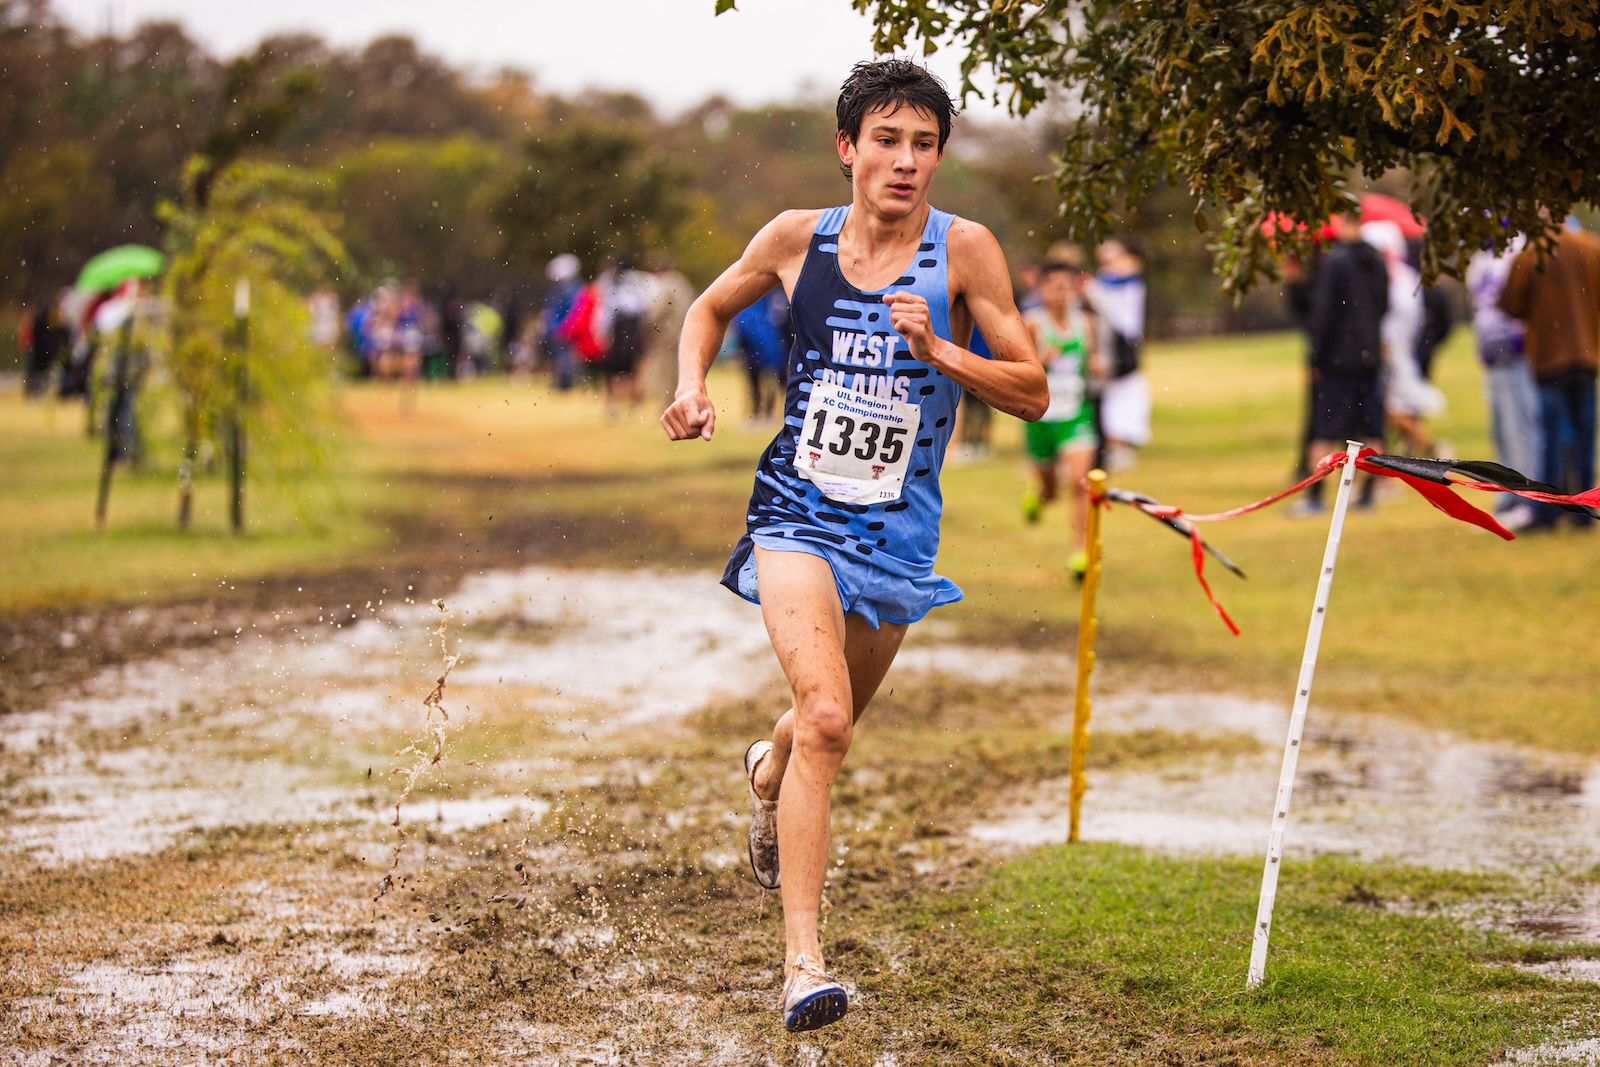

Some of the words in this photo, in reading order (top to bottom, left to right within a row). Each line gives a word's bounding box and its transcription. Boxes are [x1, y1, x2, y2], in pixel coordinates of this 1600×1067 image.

[832, 330, 899, 368] WEST
[822, 396, 836, 407] XC
[837, 401, 904, 424] Championship
[837, 390, 852, 401] UIL
[855, 395, 888, 411] Region
[807, 409, 908, 464] 1335
[879, 491, 895, 499] 1335
